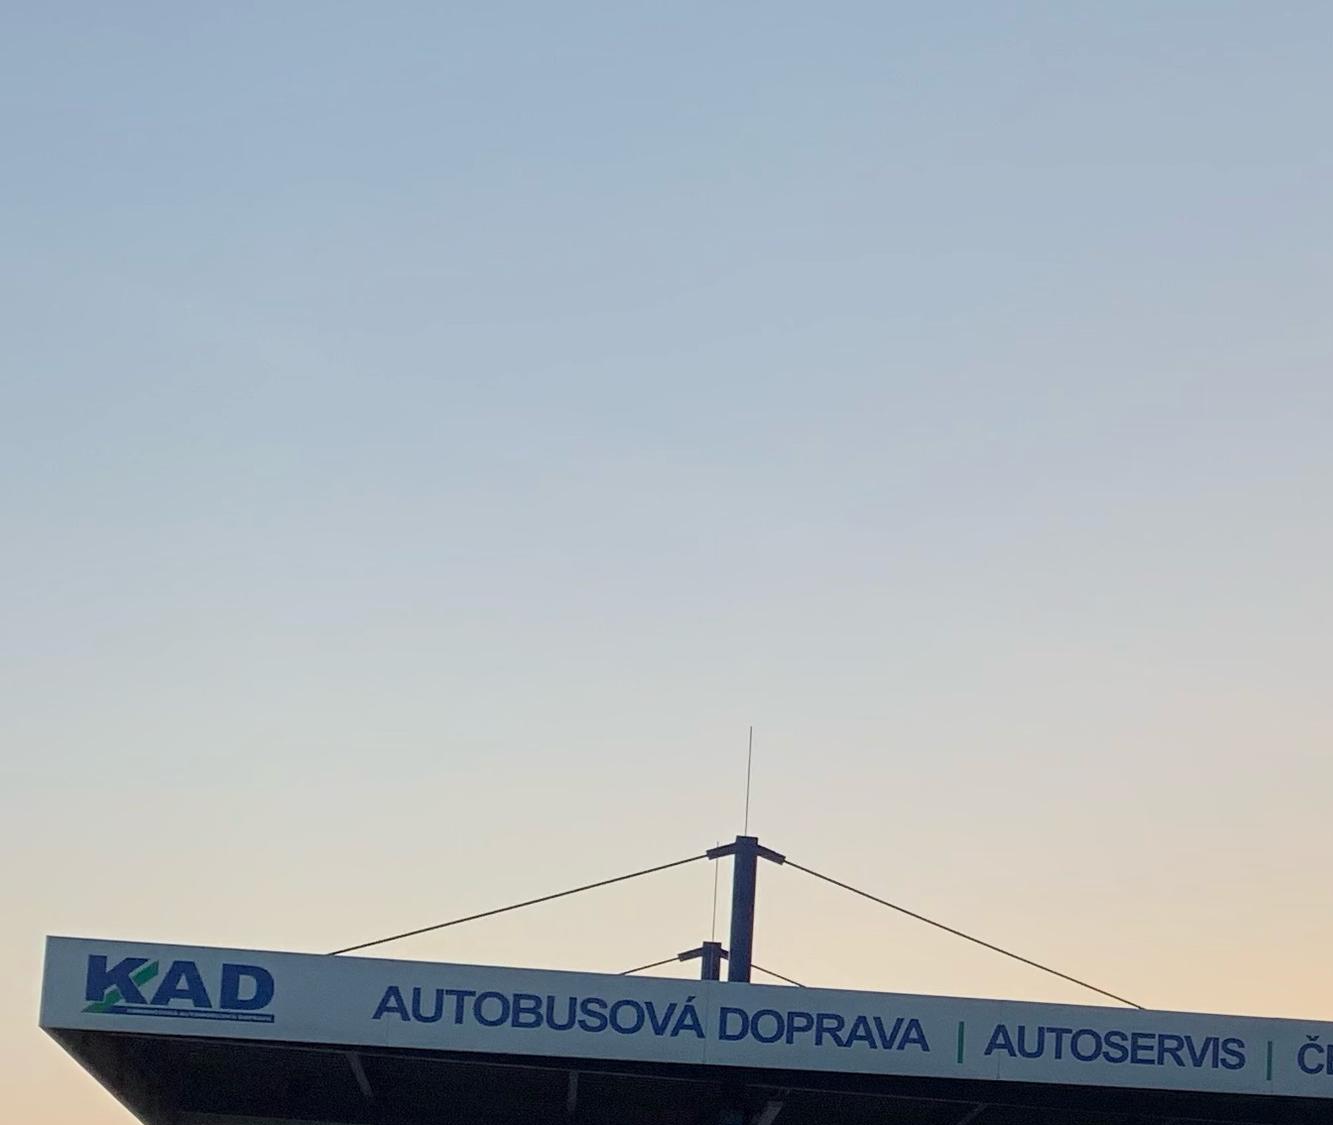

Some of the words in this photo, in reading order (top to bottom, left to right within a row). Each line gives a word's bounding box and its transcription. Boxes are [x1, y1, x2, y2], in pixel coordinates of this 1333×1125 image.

[85, 954, 275, 1011] KAD
[372, 985, 705, 1039] AUTOBUSOVÁ
[719, 1007, 930, 1053] DOPRAVA
[985, 1024, 1247, 1071] AUTOSERVIS
